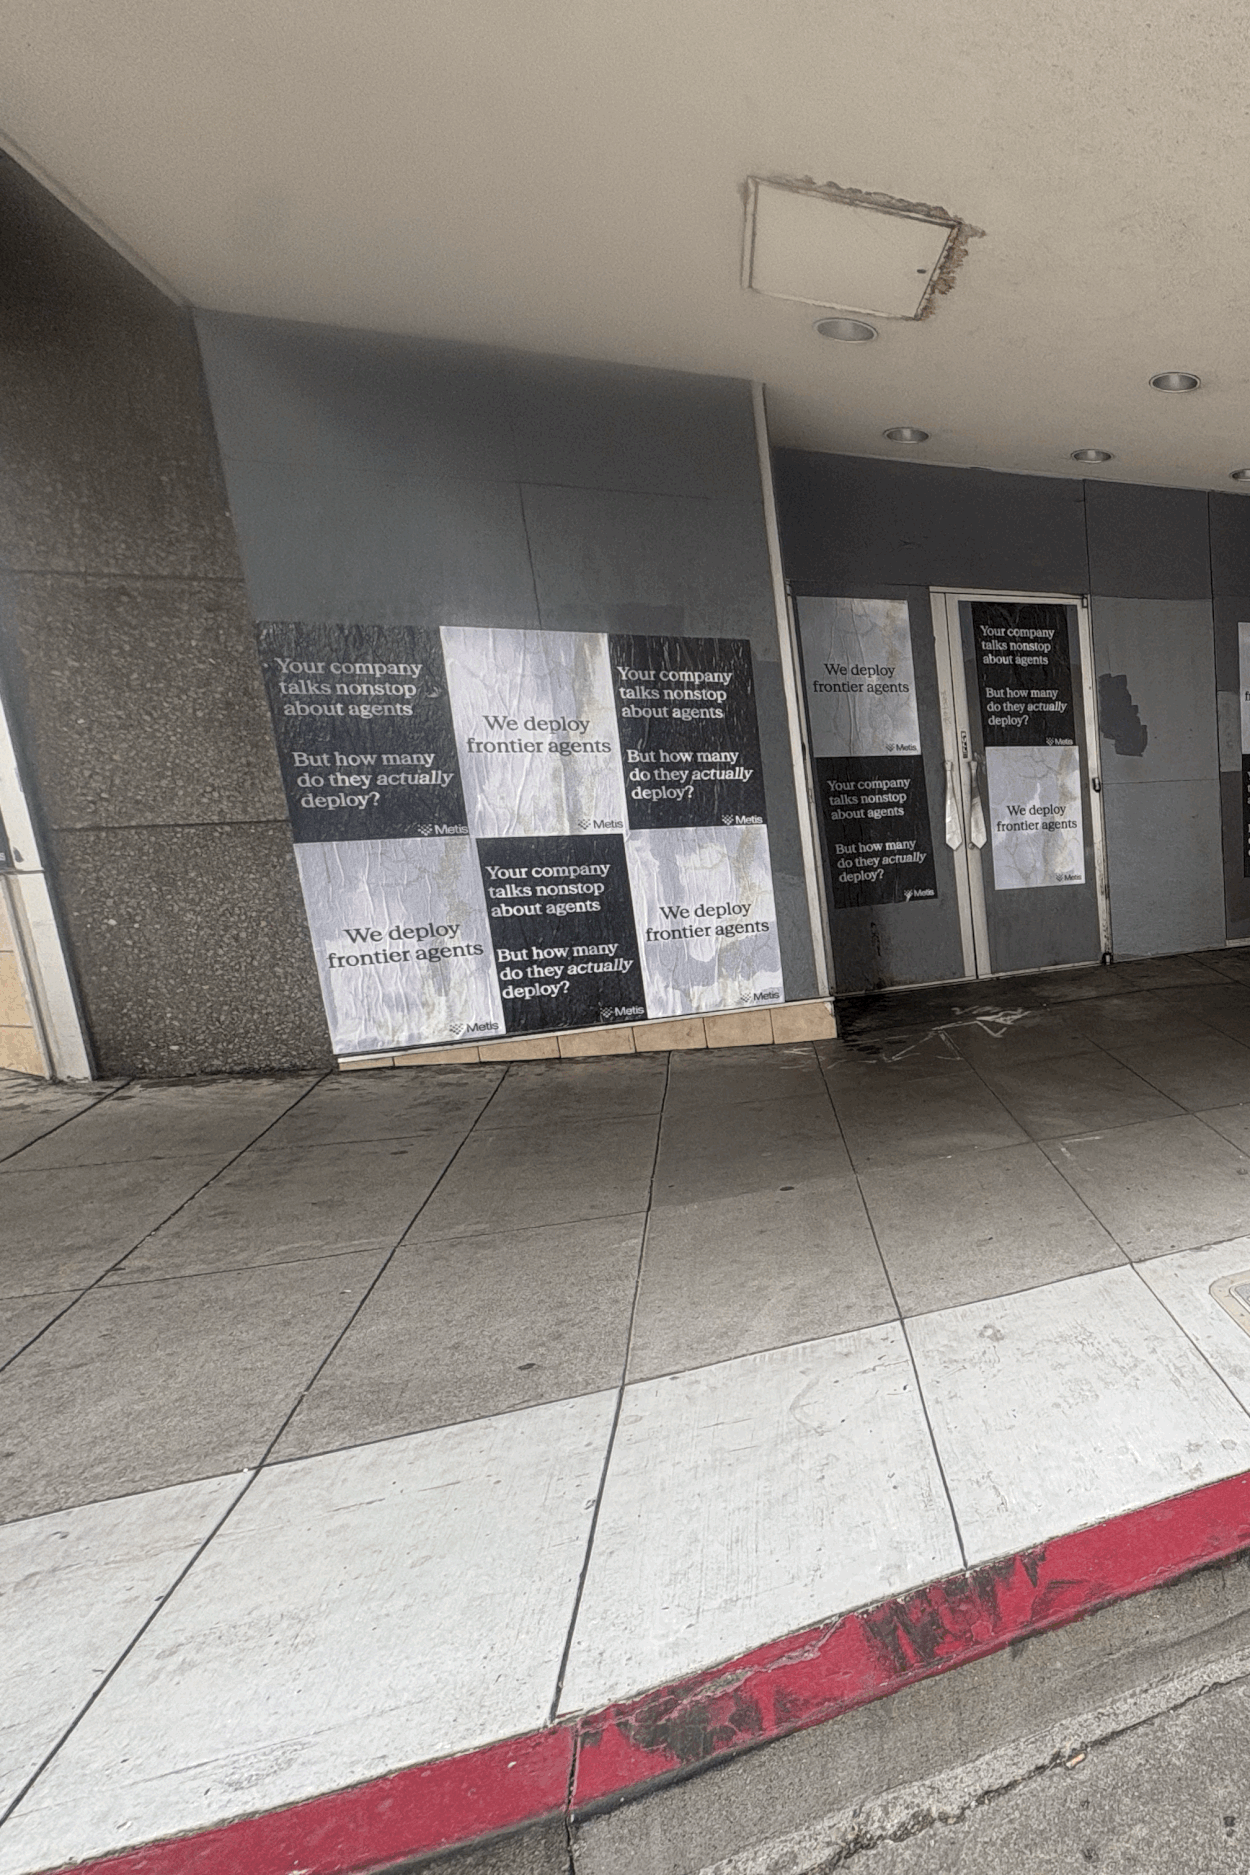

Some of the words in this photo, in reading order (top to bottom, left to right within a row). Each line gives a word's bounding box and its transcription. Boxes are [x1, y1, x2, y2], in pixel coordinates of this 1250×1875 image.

[980, 625, 1005, 636] Your
[1007, 628, 1054, 639] company
[981, 639, 1007, 650] talks
[1009, 642, 1051, 653] nonstop
[982, 653, 1013, 664] about
[1015, 656, 1048, 666] agents
[617, 666, 656, 680] Your
[659, 670, 732, 685] company
[823, 663, 847, 675] We
[850, 664, 895, 678] deploy
[619, 685, 659, 699] talks
[663, 689, 726, 703] nonstop
[813, 680, 863, 692] frontier
[866, 683, 909, 695] agents
[985, 687, 1004, 697] But
[1006, 687, 1028, 697] how
[1030, 689, 1058, 699] many
[622, 704, 668, 718] about
[672, 707, 723, 721] agents
[986, 701, 1001, 711] do
[1002, 701, 1025, 713] they
[1027, 701, 1067, 713] actually
[483, 715, 517, 731] We
[523, 716, 590, 734] deploy
[988, 714, 1028, 727] deploy?
[467, 737, 542, 753] frontier
[548, 741, 611, 756] agents
[626, 749, 655, 762] But
[659, 749, 693, 762] how
[697, 752, 739, 764] many
[629, 767, 650, 781] do
[654, 767, 688, 783] they
[691, 766, 752, 782] actually
[827, 780, 855, 790] Your
[857, 778, 910, 790] company
[631, 785, 693, 801] deploy?
[829, 794, 858, 805] talks
[860, 793, 906, 803] nonstop
[831, 809, 864, 819] about
[867, 807, 904, 819] agents
[1006, 805, 1026, 815] We
[1028, 804, 1066, 817] deploy
[592, 819, 622, 828] Metis
[735, 815, 763, 824] Metis
[997, 820, 1039, 831] frontier
[1041, 820, 1077, 831] agents
[835, 843, 856, 854] But
[858, 842, 883, 852] how
[885, 840, 916, 850] many
[837, 857, 853, 868] do
[855, 856, 880, 867] they
[882, 851, 926, 864] actually
[485, 865, 528, 879] Your
[531, 864, 609, 878] company
[839, 868, 883, 883] deploy?
[488, 884, 532, 898] talks
[536, 883, 604, 896] nonstop
[491, 903, 541, 917] about
[546, 900, 600, 916] agents
[659, 905, 689, 919] We
[694, 902, 751, 918] deploy
[344, 927, 382, 943] We
[388, 922, 459, 941] deploy
[646, 925, 710, 941] frontier
[715, 921, 769, 937] agents
[328, 949, 409, 968] frontier
[415, 943, 483, 962] agents
[497, 948, 528, 962] But
[531, 946, 568, 959] how
[572, 943, 618, 956] many
[500, 967, 523, 980] do
[526, 965, 564, 978] they
[567, 958, 632, 974] actually
[502, 980, 569, 999] deploy?
[753, 991, 779, 1000] Metis
[614, 1006, 644, 1015] Metis
[466, 1021, 498, 1031] Metis
